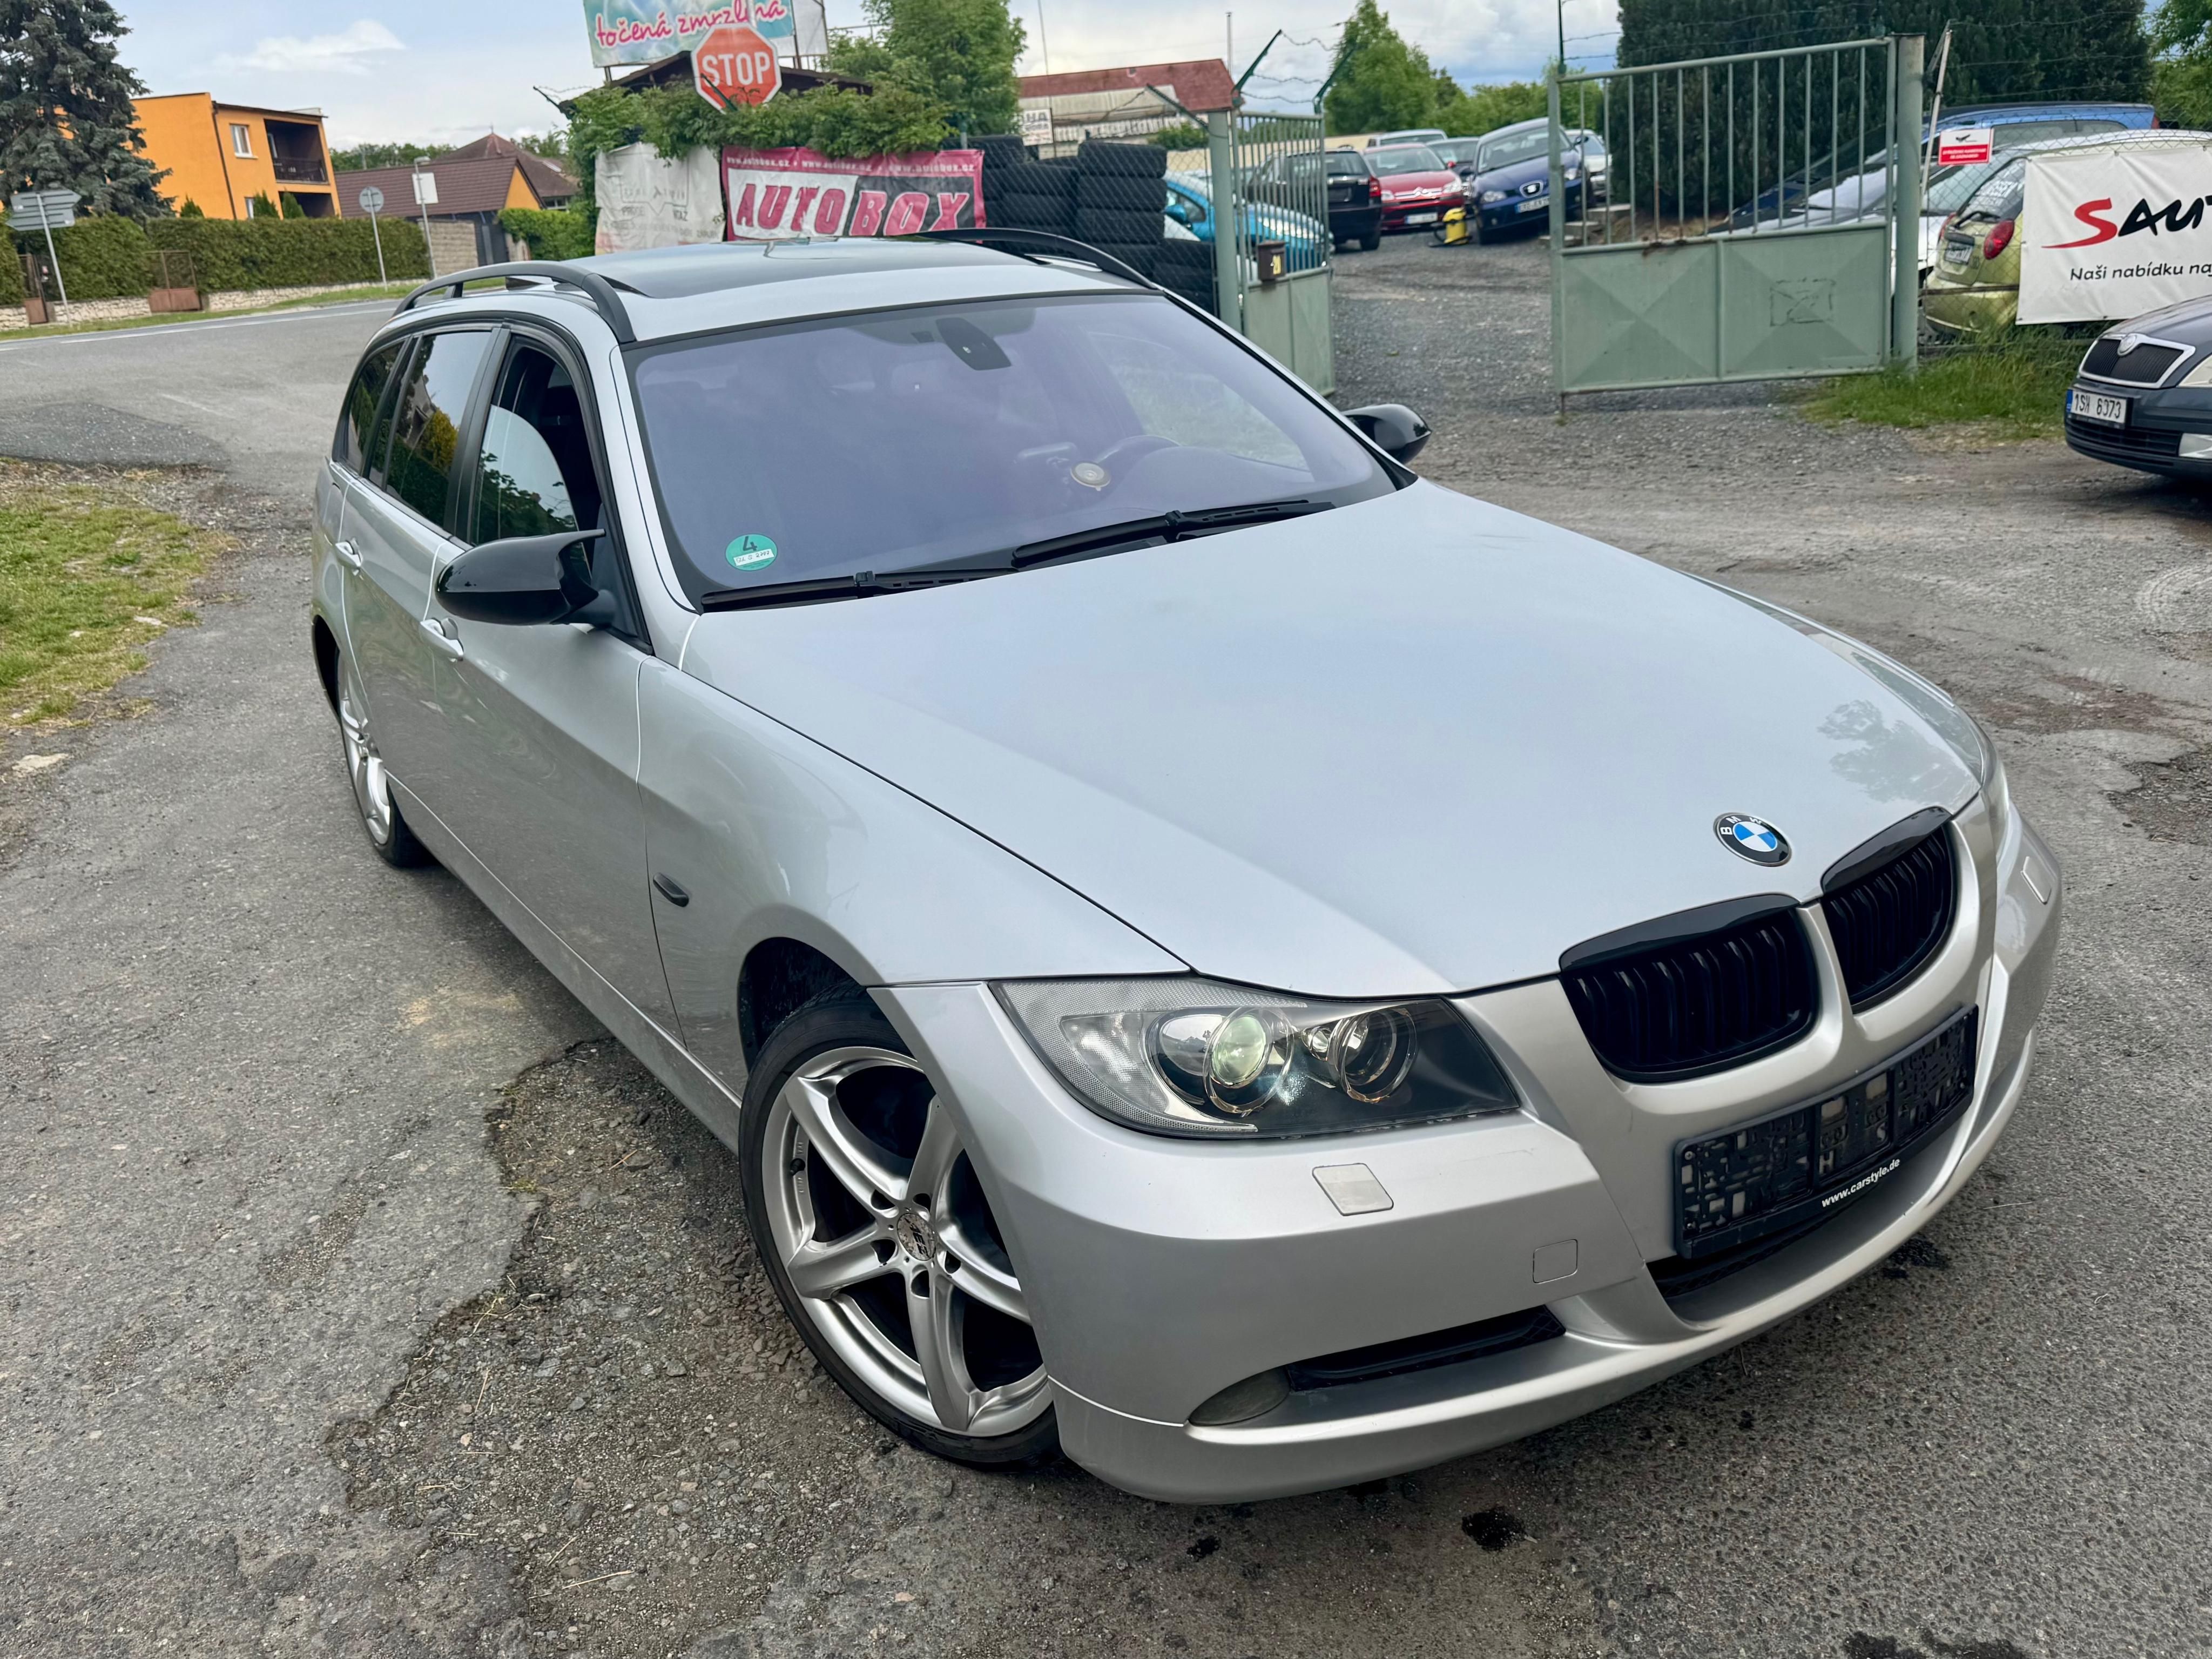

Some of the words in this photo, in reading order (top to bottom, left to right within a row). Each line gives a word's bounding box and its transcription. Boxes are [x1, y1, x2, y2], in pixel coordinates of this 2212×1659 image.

[597, 12, 671, 46] točená
[703, 52, 770, 86] STOP
[2070, 265, 2107, 281] Naši
[2112, 261, 2183, 278] nabídku
[743, 535, 758, 551] 4
[1720, 816, 1762, 835] BMW
[1822, 1158, 1900, 1208] www.carstyle.de
